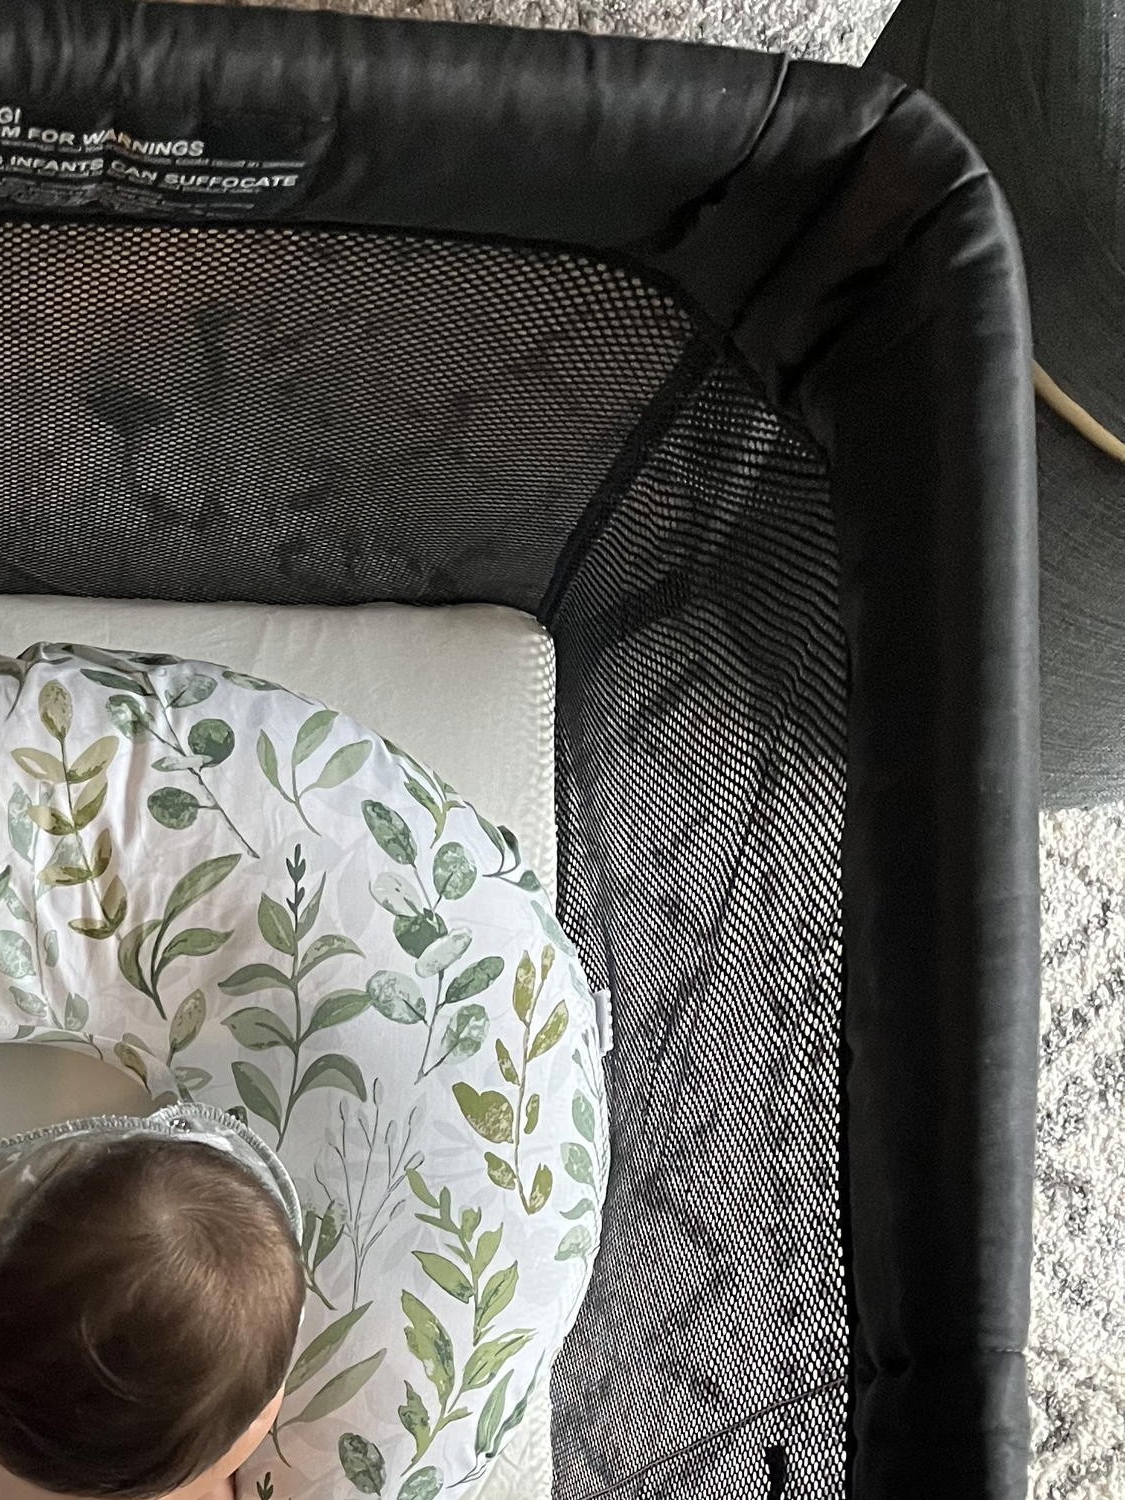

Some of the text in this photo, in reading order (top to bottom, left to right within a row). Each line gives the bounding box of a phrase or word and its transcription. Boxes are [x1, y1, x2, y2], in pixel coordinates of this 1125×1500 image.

[27, 127, 75, 145] FOR
[82, 129, 205, 156] WARNINGS
[10, 156, 104, 172] INFANTS
[111, 160, 157, 181] CAN
[164, 174, 299, 188] SUFFOCATE
